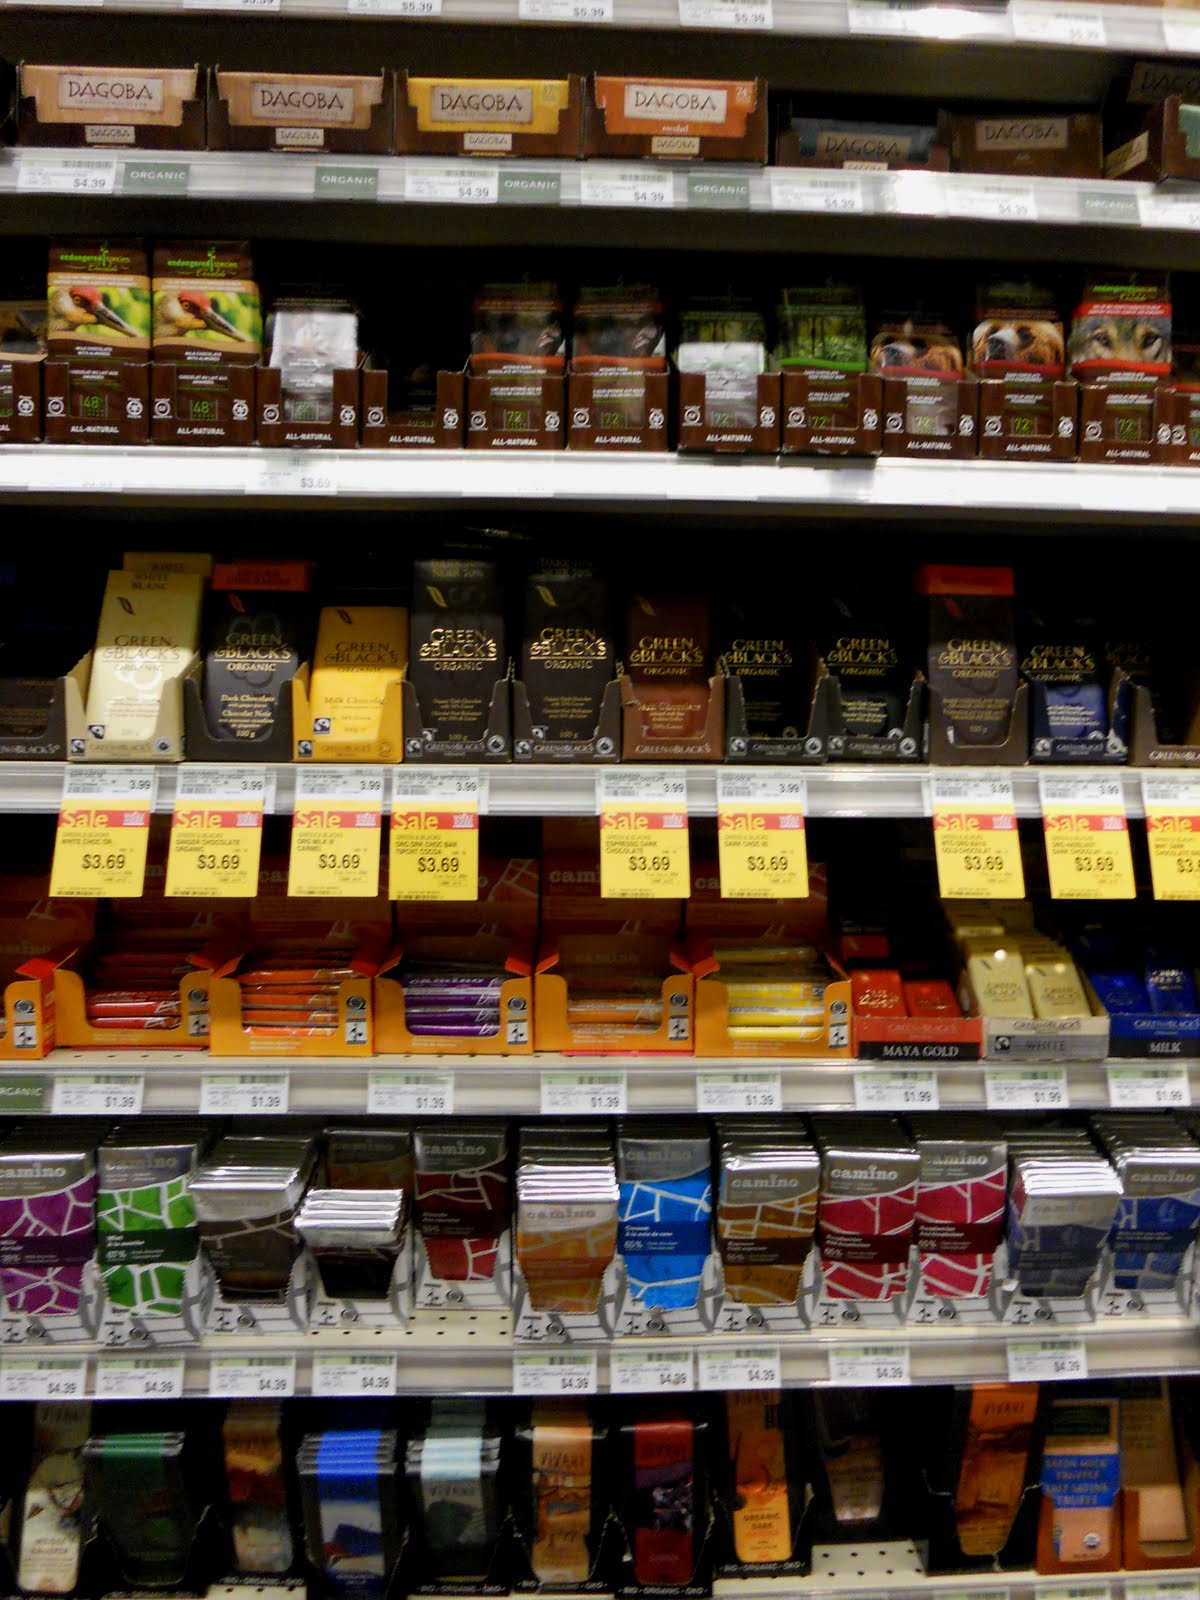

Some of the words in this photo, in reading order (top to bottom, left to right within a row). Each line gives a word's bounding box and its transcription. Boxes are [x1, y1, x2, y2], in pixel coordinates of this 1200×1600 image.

[68, 80, 153, 101] DAGOBA
[261, 89, 345, 111] DAGOBA
[440, 93, 523, 112] DAGOBA
[635, 91, 718, 111] DAGOBA
[90, 128, 131, 138] DAGOBA
[280, 130, 320, 140] DAGOBA
[985, 121, 1060, 140] DAGOBA
[824, 137, 901, 157] DAGOBA
[130, 170, 187, 181] ORGANIC
[321, 175, 376, 186] ORGANIC
[73, 178, 106, 189] $4.39
[504, 180, 558, 191] ORGANIC
[694, 184, 748, 196] ORGANIC
[458, 187, 489, 198] $4.39
[634, 192, 664, 203] $4.39
[114, 635, 171, 647] GREEN
[225, 633, 282, 647] GREEN
[430, 628, 487, 644] GREEN
[540, 628, 596, 643] GREEN
[336, 641, 390, 652] GREEN
[420, 639, 497, 658] &BLACK'S
[530, 637, 606, 657] &BLACK'S
[639, 637, 693, 650] GREEN
[732, 639, 784, 651] GREEN
[836, 637, 890, 650] GREEN
[948, 640, 1001, 652] GREEN
[227, 663, 277, 672] ORGANIC
[433, 660, 483, 671] ORGANIC
[544, 660, 593, 670] ORGANIC
[130, 780, 151, 790] 3.99
[241, 781, 263, 791] 3.99
[360, 780, 381, 791] 3.99
[456, 782, 477, 792] 3.99
[62, 811, 108, 828] Sale
[176, 811, 222, 828] Sale
[296, 811, 341, 828] Sale
[393, 812, 439, 830] Sale
[602, 813, 648, 830] Sale
[720, 813, 766, 831] Sale
[936, 814, 979, 831] Sale
[1046, 815, 1090, 832] Sale
[1151, 816, 1193, 833] Sale
[82, 854, 126, 869] $3.69
[197, 854, 240, 870] $3.69
[319, 854, 361, 869] $3.69
[418, 857, 459, 873] $3.69
[629, 856, 670, 871] $3.69
[747, 856, 788, 871] $3.69
[964, 856, 1004, 871] $3.69
[1075, 857, 1115, 872] $3.69
[883, 1045, 920, 1056] MAYA
[922, 1045, 959, 1056] GOLD
[1150, 1041, 1181, 1053] MILK
[831, 1165, 898, 1181] camino
[1130, 1169, 1195, 1184] camino
[731, 1173, 798, 1188] camino
[876, 1367, 904, 1379] $4.39
[1053, 1361, 1080, 1373] $4.39
[660, 1373, 687, 1385] $4.39
[748, 1370, 776, 1381] $4.39
[48, 1382, 77, 1394] $4.39
[144, 1381, 173, 1392] $4.39
[258, 1379, 287, 1391] $4.39
[361, 1377, 390, 1388] $4.39
[560, 1377, 589, 1389] $4.39
